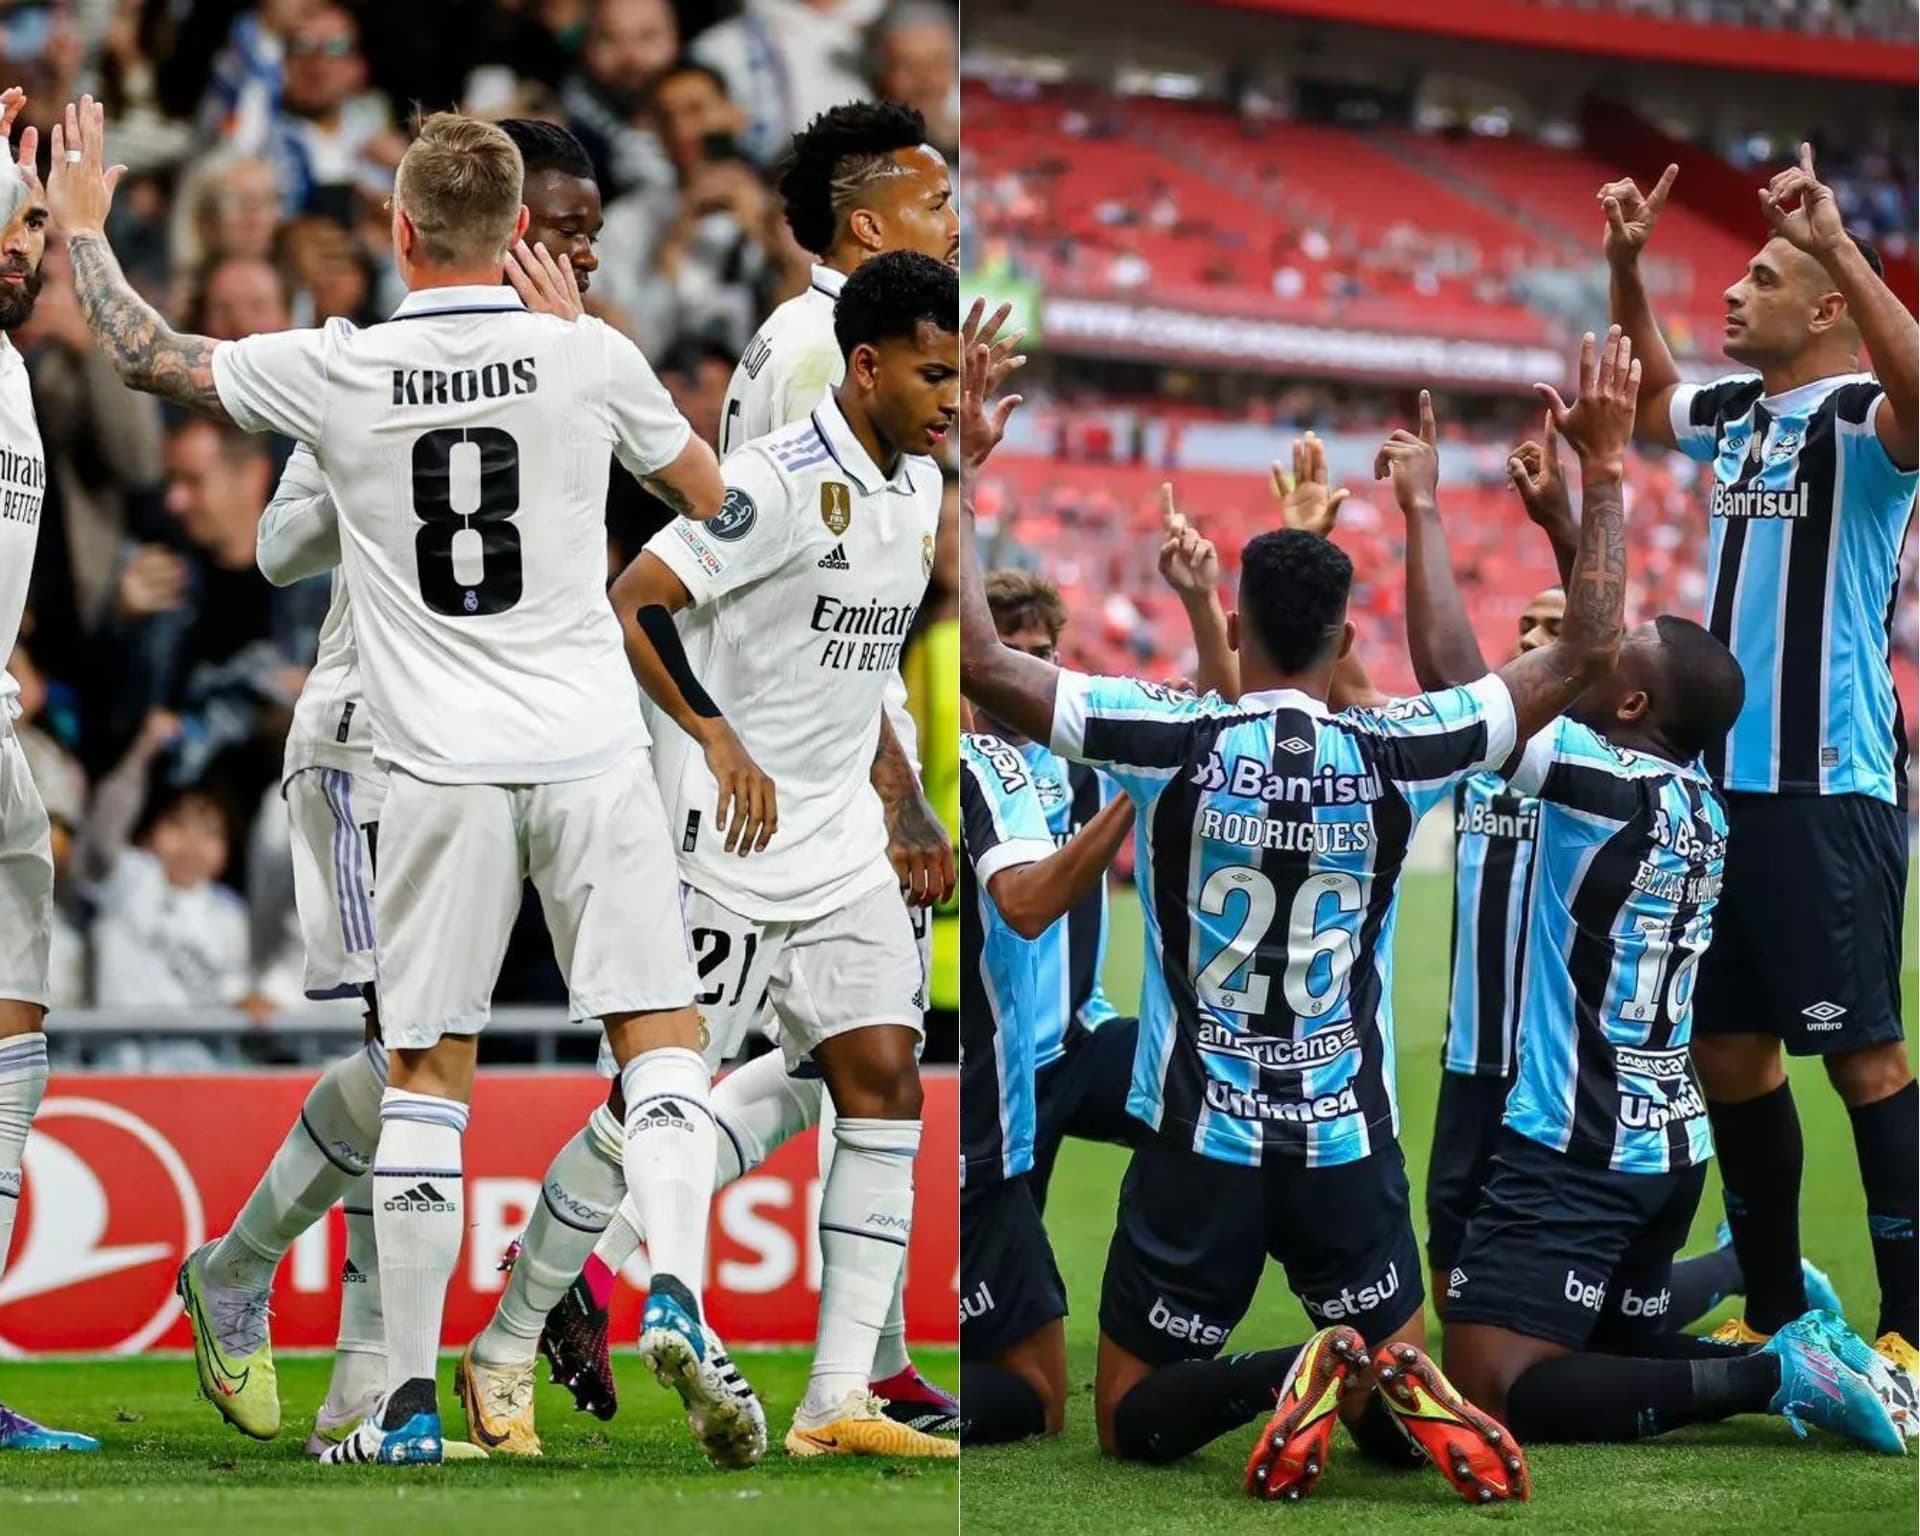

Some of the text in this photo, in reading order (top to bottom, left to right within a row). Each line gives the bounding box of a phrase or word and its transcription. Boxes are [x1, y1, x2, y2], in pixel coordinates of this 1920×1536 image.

[391, 357, 538, 405] KROOS
[1712, 481, 1809, 518] Banrisul
[412, 427, 523, 616] 8
[818, 559, 850, 570] adidas
[820, 639, 856, 670] FLY
[1230, 756, 1385, 804] Banrisul
[1200, 808, 1370, 854] RODRIGUES
[1631, 860, 1685, 902] ELIAS
[1196, 865, 1363, 1018] 26
[691, 927, 757, 1007] 21
[1198, 1021, 1355, 1064] amricanas
[1806, 1020, 1843, 1032] umbro
[1206, 1078, 1359, 1122] Unimed
[628, 1114, 695, 1141] adidas
[384, 1200, 456, 1212] adidas
[1302, 1261, 1400, 1320] betsul
